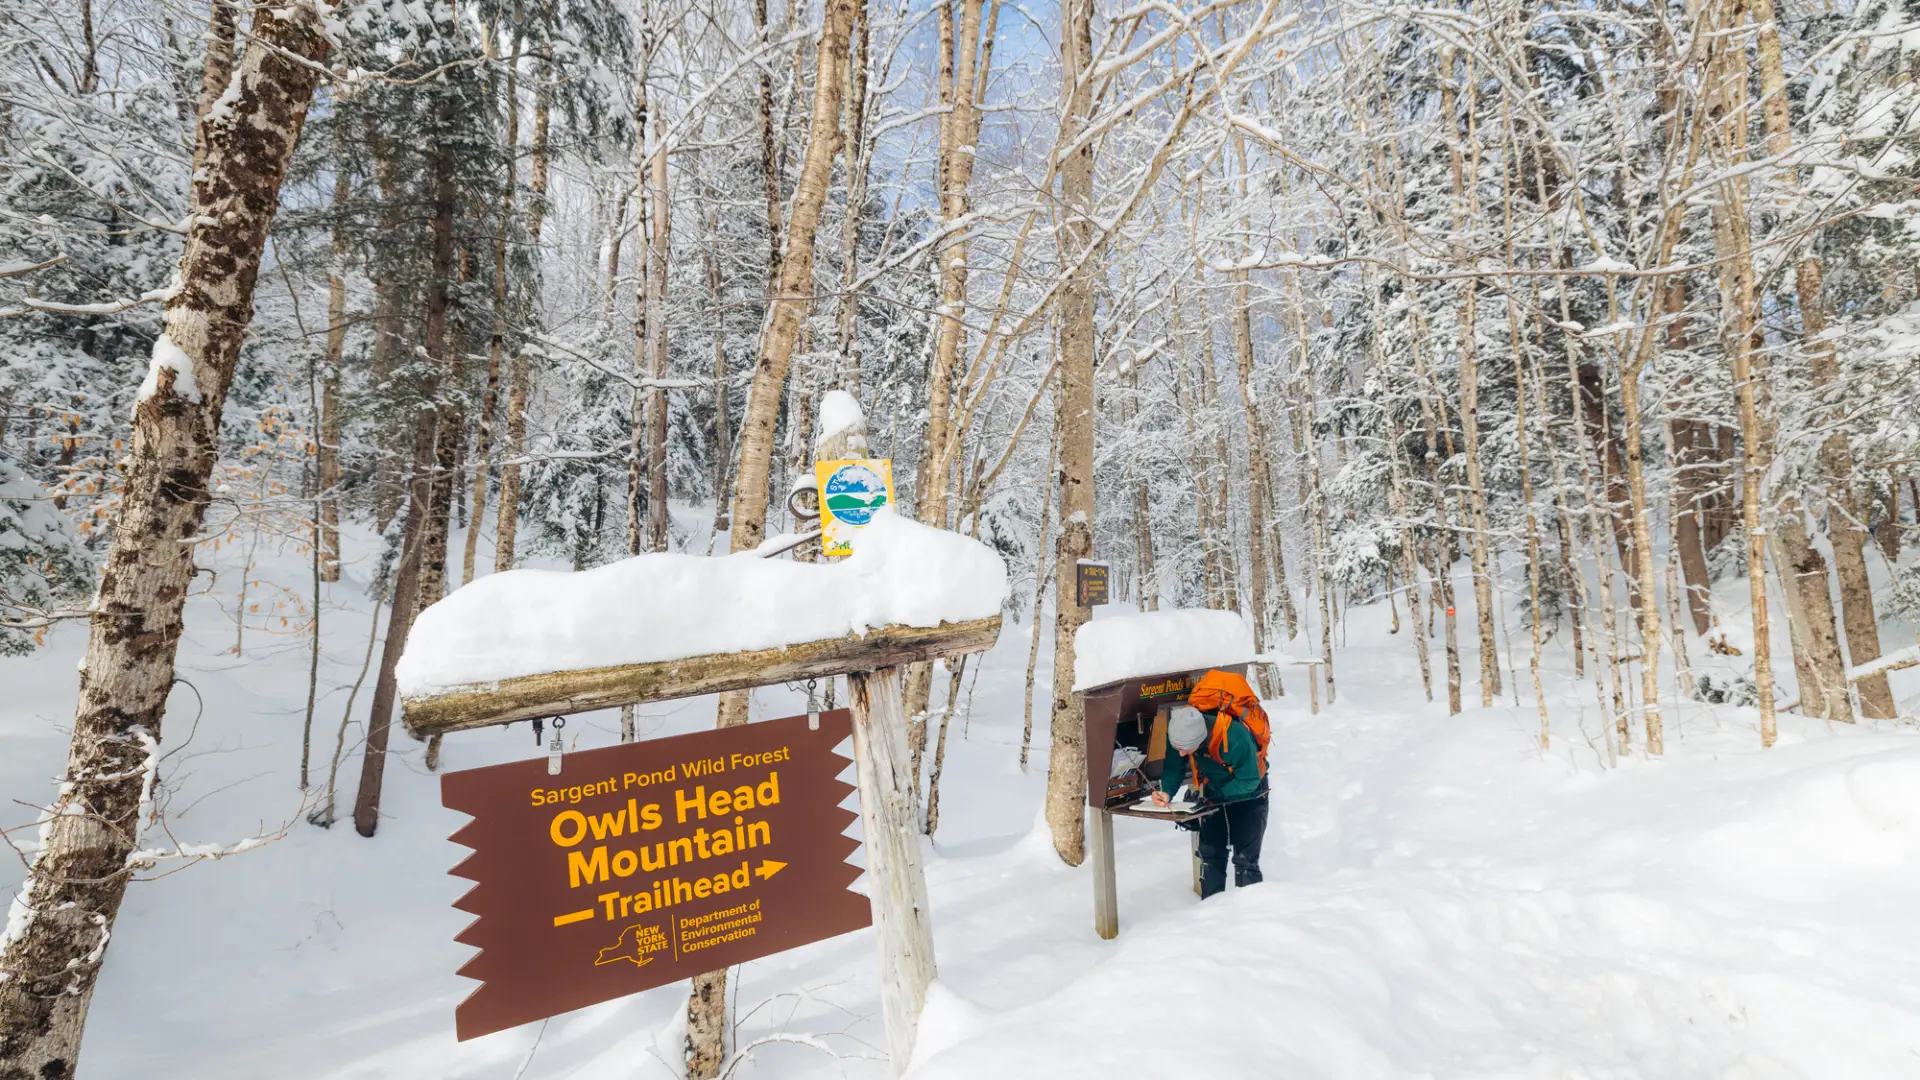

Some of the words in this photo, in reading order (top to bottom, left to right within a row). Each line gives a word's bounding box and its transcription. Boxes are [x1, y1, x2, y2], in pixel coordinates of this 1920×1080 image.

[530, 776, 618, 807] Sargent
[623, 764, 677, 790] Pond
[681, 757, 726, 779] Wild
[730, 745, 791, 771] Forest
[549, 797, 663, 848] Owls
[674, 771, 781, 825] Head
[567, 815, 772, 889] Mountain
[597, 860, 751, 922] Trailhead
[679, 903, 748, 930] Department
[749, 898, 761, 910] of
[680, 911, 763, 942] Environmental
[635, 925, 660, 939] NEW
[636, 932, 666, 947] YORK
[682, 926, 756, 952] Conservation
[637, 941, 669, 956] STATE
